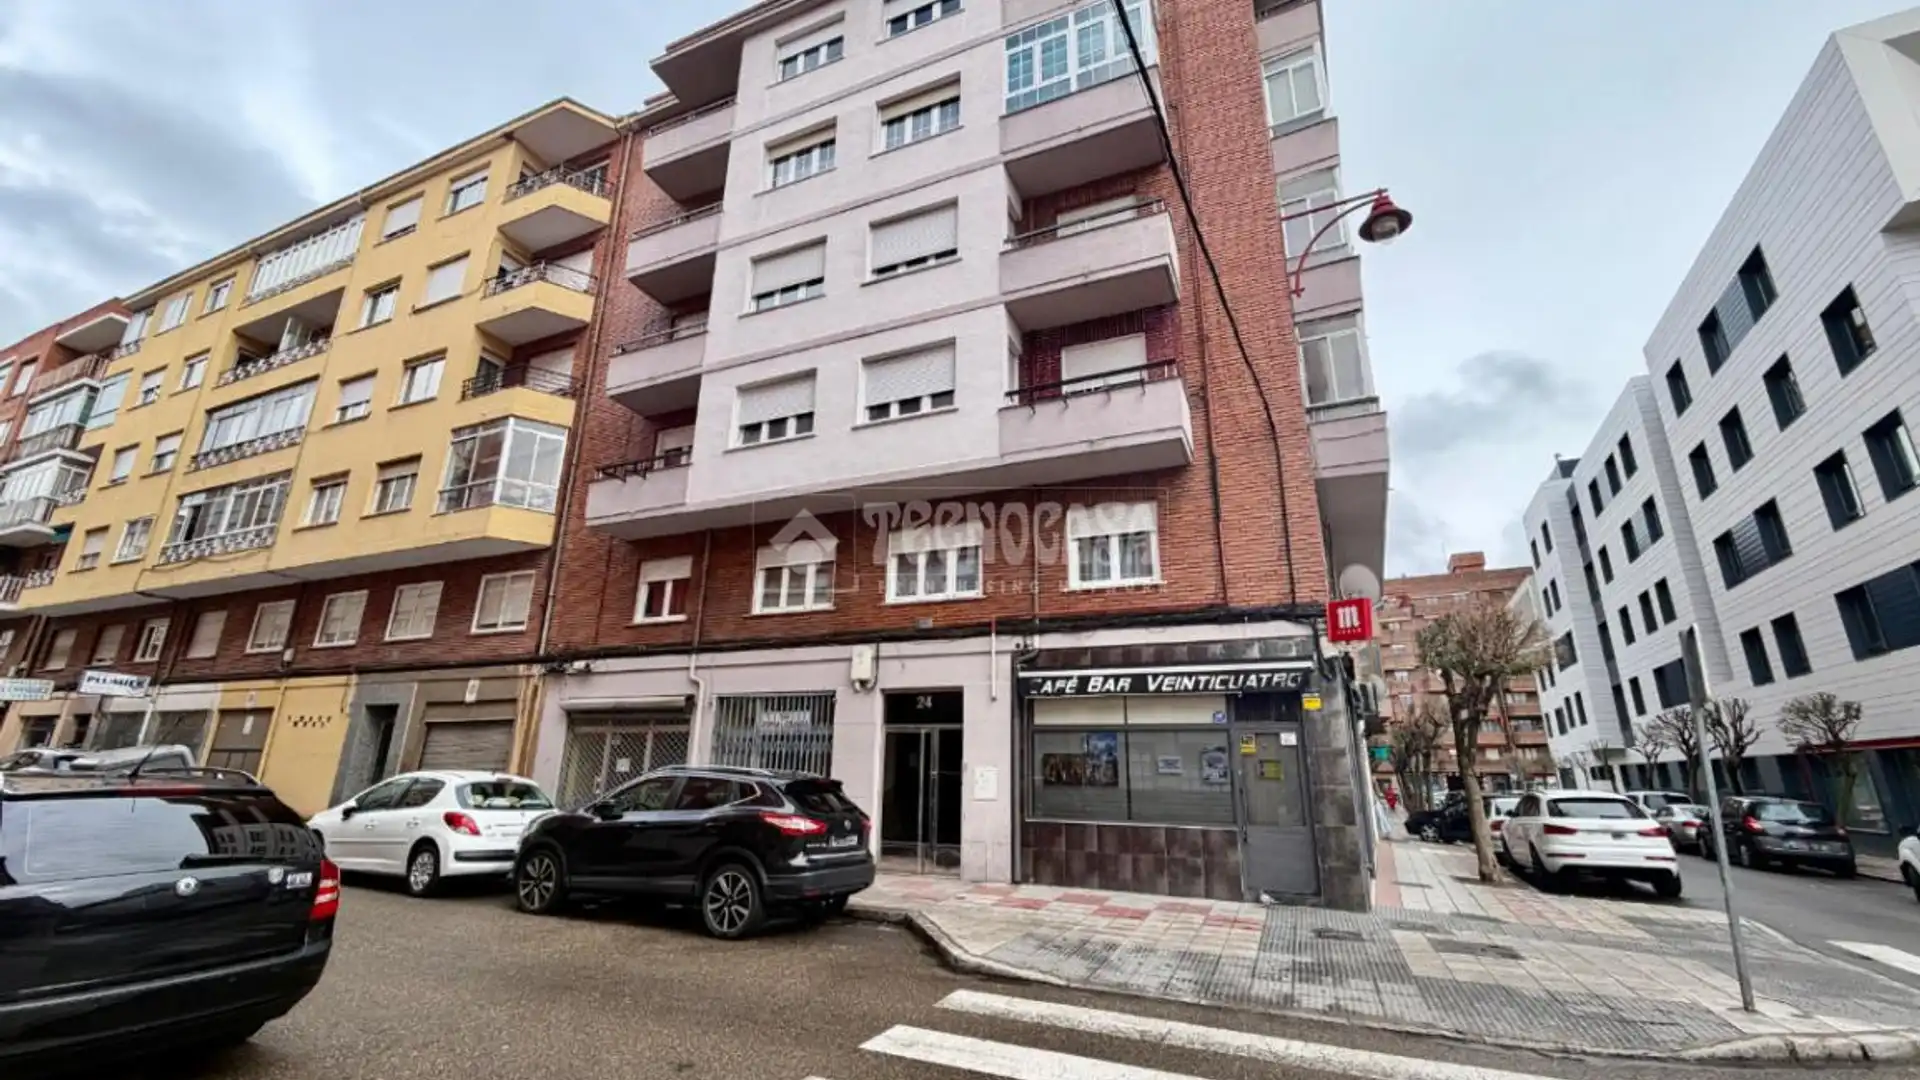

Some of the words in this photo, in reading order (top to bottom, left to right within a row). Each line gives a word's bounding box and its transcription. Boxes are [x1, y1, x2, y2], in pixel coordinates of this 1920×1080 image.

[1029, 674, 1079, 695] CAFÉ
[1087, 675, 1131, 693] BAR
[1147, 672, 1303, 692] VEINTICUATRO
[915, 695, 933, 709] 24
